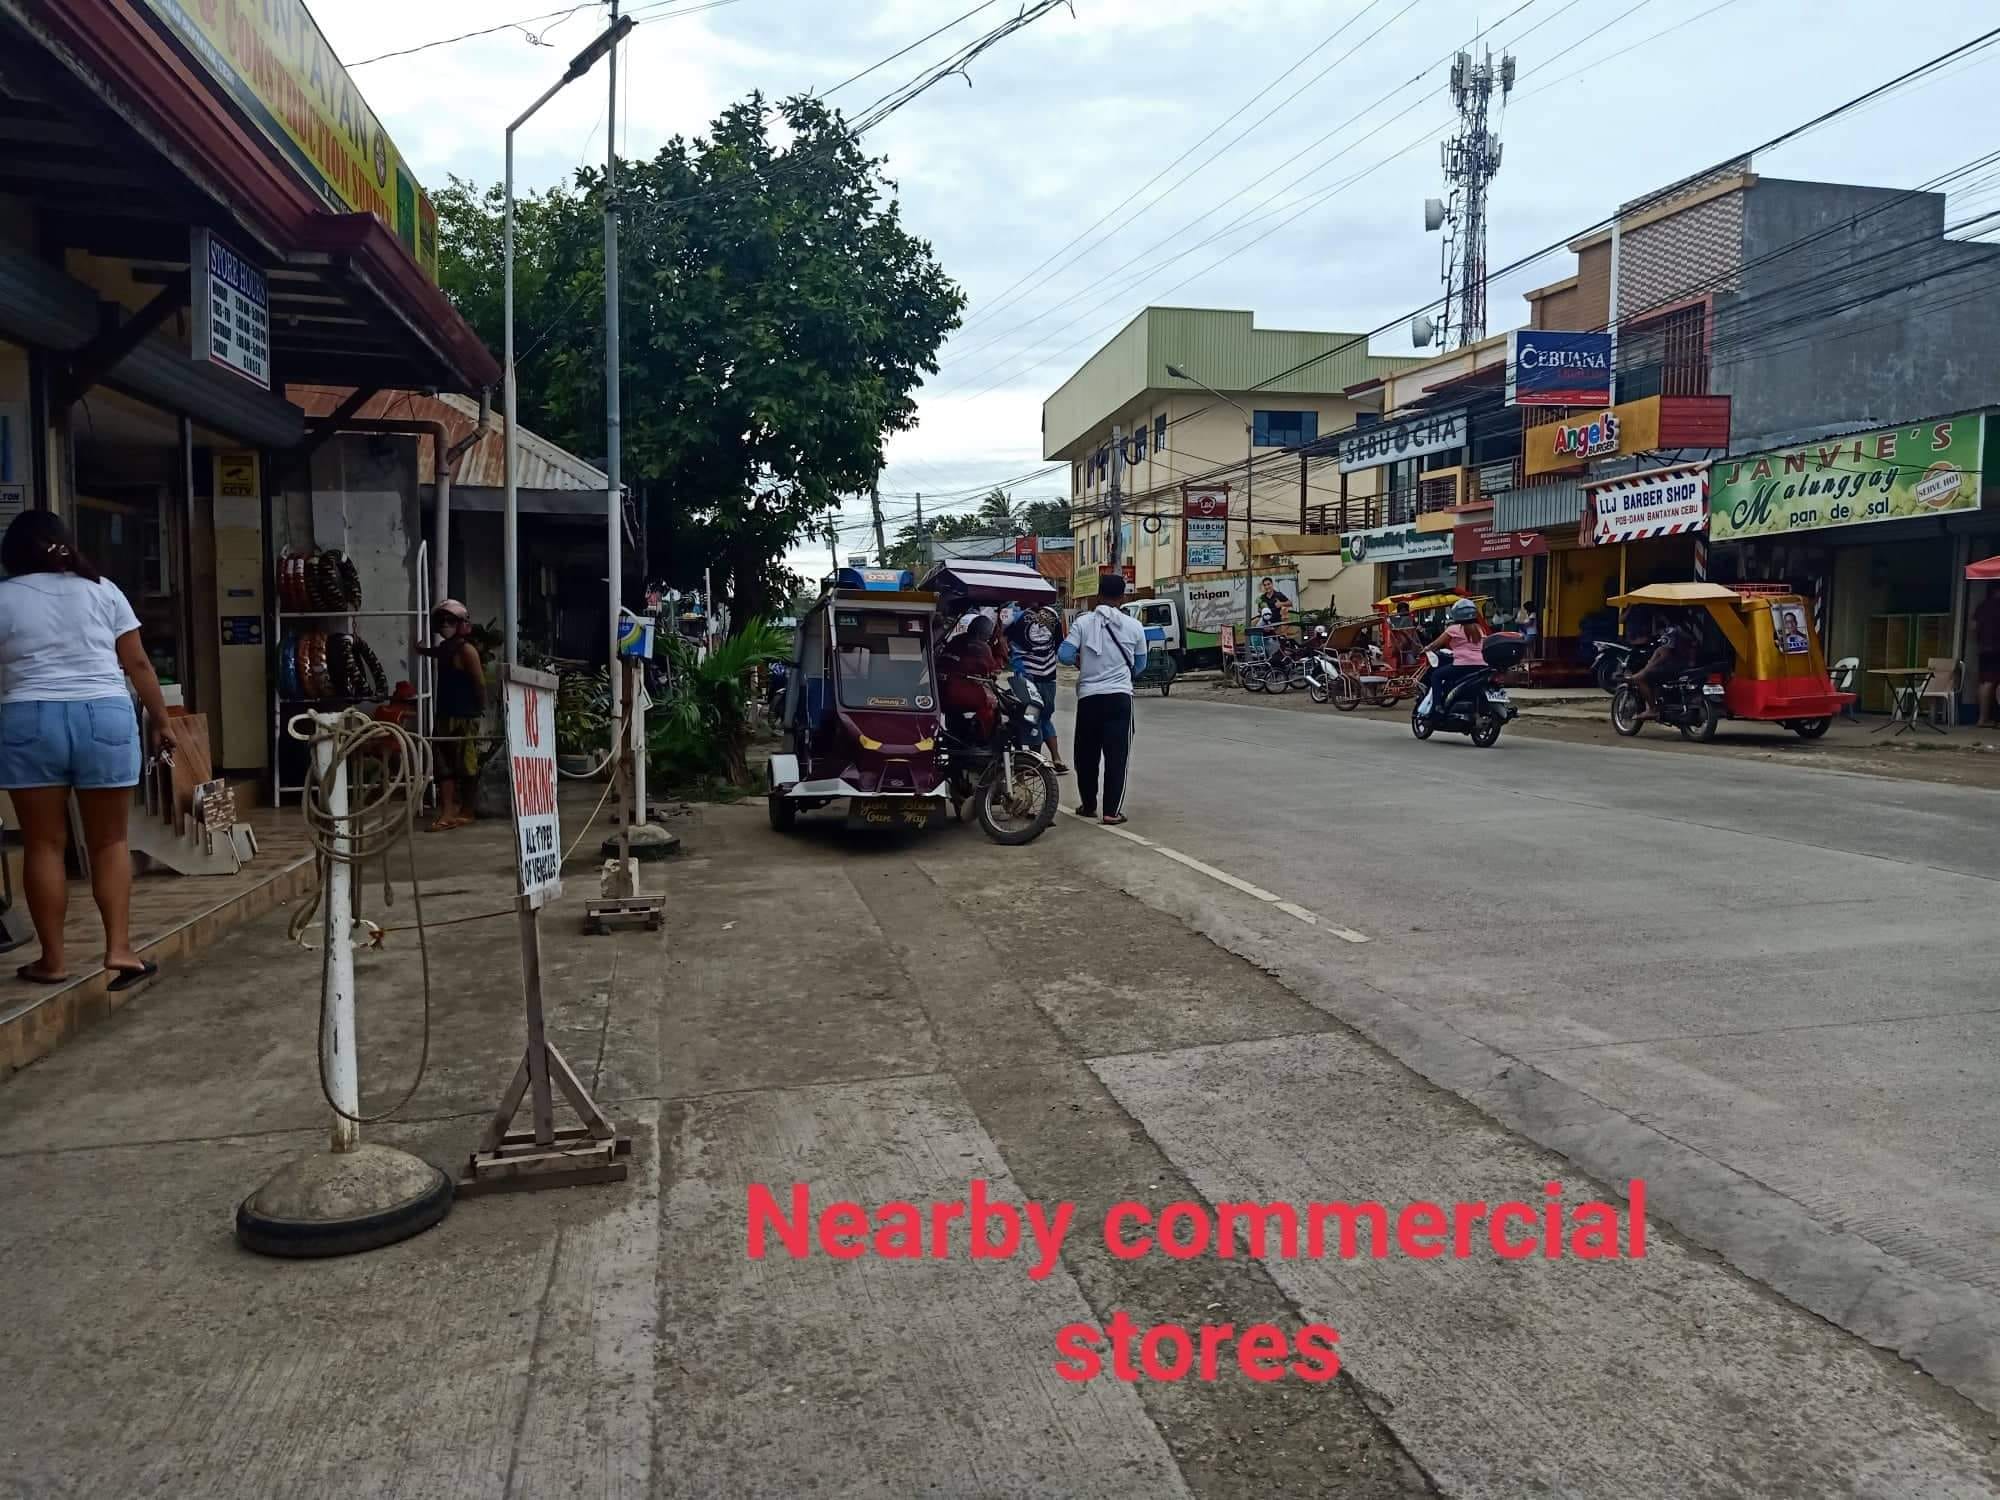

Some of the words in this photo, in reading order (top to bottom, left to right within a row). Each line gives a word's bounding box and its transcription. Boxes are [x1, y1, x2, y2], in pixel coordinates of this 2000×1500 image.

[210, 239, 239, 285] STORE
[239, 260, 266, 306] HOURS
[1519, 343, 1607, 369] CEBUANA
[1554, 412, 1616, 458] Angel's
[1588, 440, 1615, 455] BURGER
[1726, 423, 1953, 486] JANVIE'S
[1600, 497, 1617, 515] LLJ
[1624, 491, 1663, 510] BARBER
[1666, 483, 1696, 503] SHOP
[1648, 508, 1680, 521] BANTAYAN
[1681, 504, 1698, 516] CEBU
[1731, 466, 1900, 530] Malunggay
[1790, 509, 1817, 527] pan
[1830, 506, 1849, 519] de
[1868, 497, 1889, 516] sal
[523, 687, 539, 748] NO
[513, 756, 555, 817] PARKING
